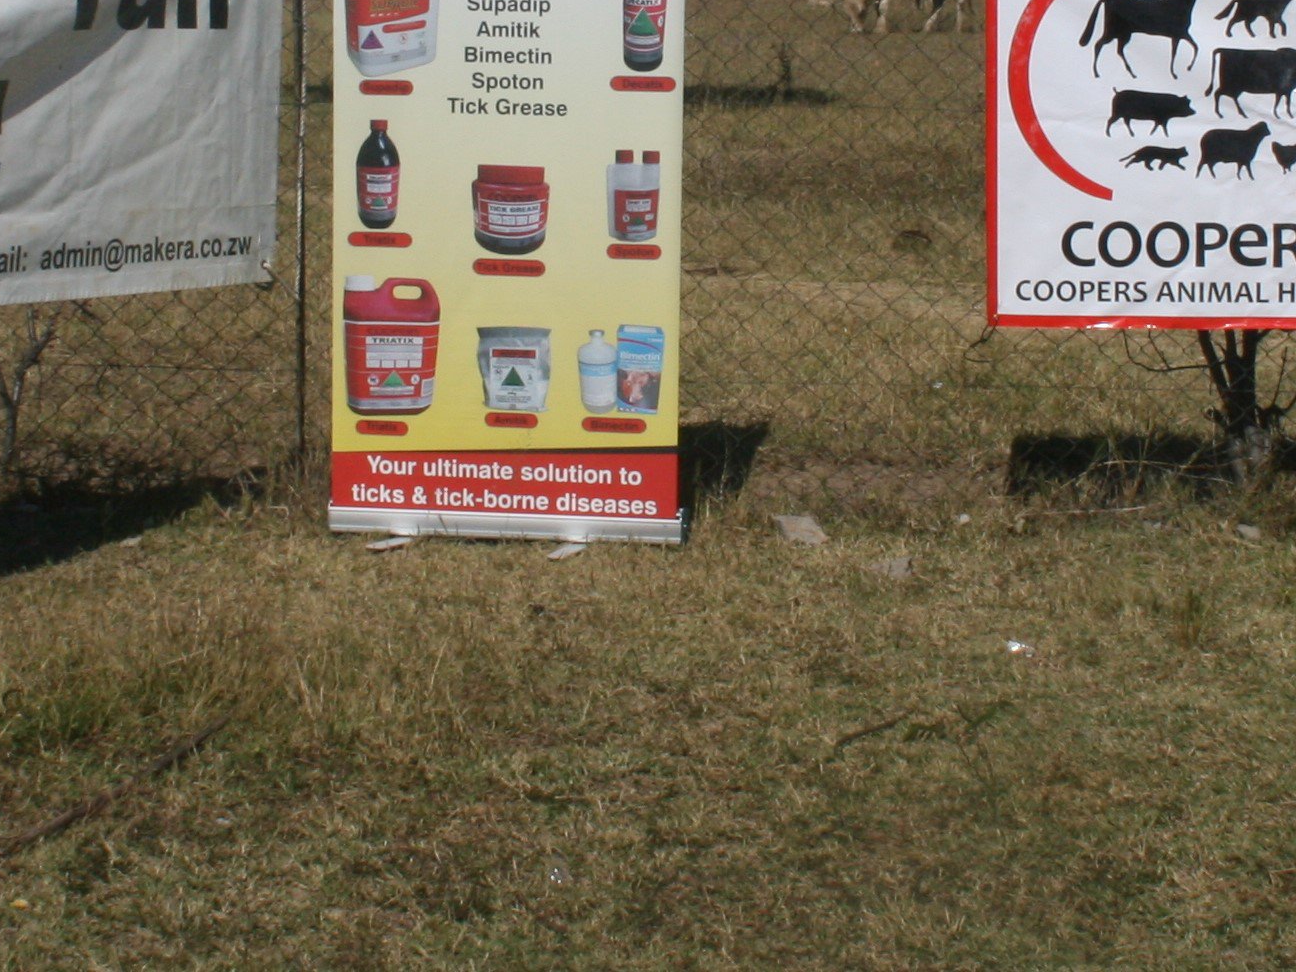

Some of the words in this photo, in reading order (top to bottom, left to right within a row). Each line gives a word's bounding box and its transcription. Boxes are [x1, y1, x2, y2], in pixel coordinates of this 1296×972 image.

[476, 20, 540, 39] Amitik
[463, 46, 553, 65] Bimectin
[471, 72, 544, 95] Spoton
[447, 98, 488, 115] Tick
[495, 99, 568, 117] Grease
[39, 235, 253, 271] admin@makera.co.zw
[1015, 279, 1147, 302] COOPERS
[1156, 281, 1269, 303] ANIMAL
[367, 455, 417, 476] Your
[423, 457, 513, 481] ultimate
[521, 464, 612, 485] solution
[619, 467, 642, 486] to
[352, 484, 405, 504] ticks
[412, 487, 428, 505] &
[434, 488, 549, 511] tick-borne
[556, 493, 657, 515] diseases
